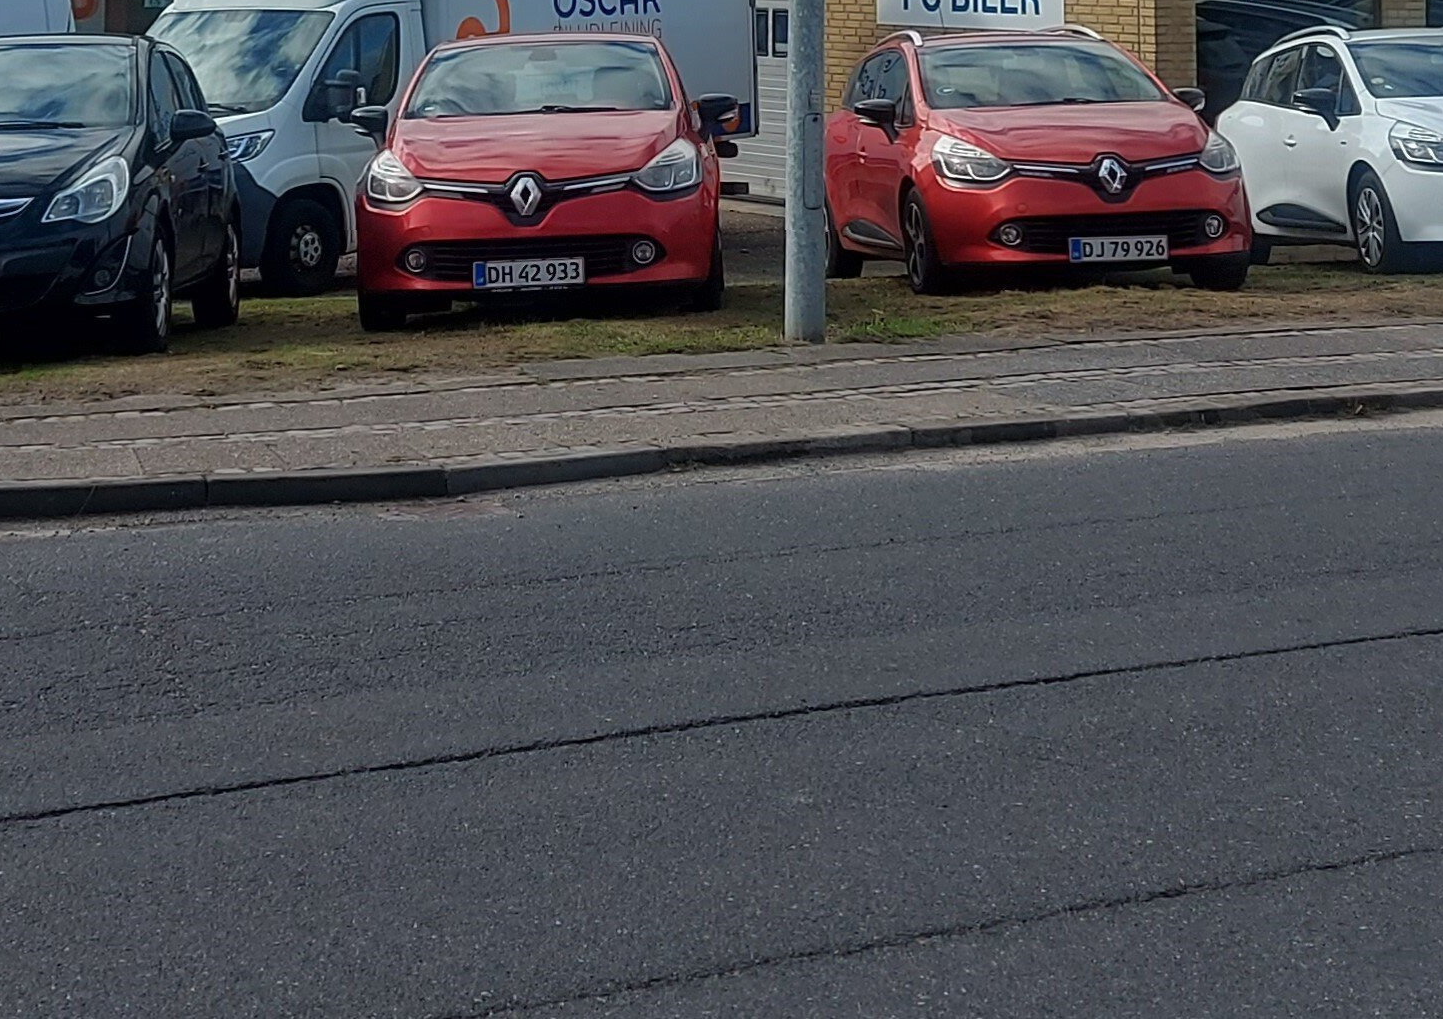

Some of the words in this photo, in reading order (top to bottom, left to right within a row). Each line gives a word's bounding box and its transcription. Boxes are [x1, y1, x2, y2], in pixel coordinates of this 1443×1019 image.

[1082, 241, 1105, 258] DJ
[1109, 241, 1131, 257] 79
[1134, 239, 1166, 257] 926
[487, 265, 514, 284] DH
[518, 263, 542, 283] 42
[545, 261, 580, 282] 933
